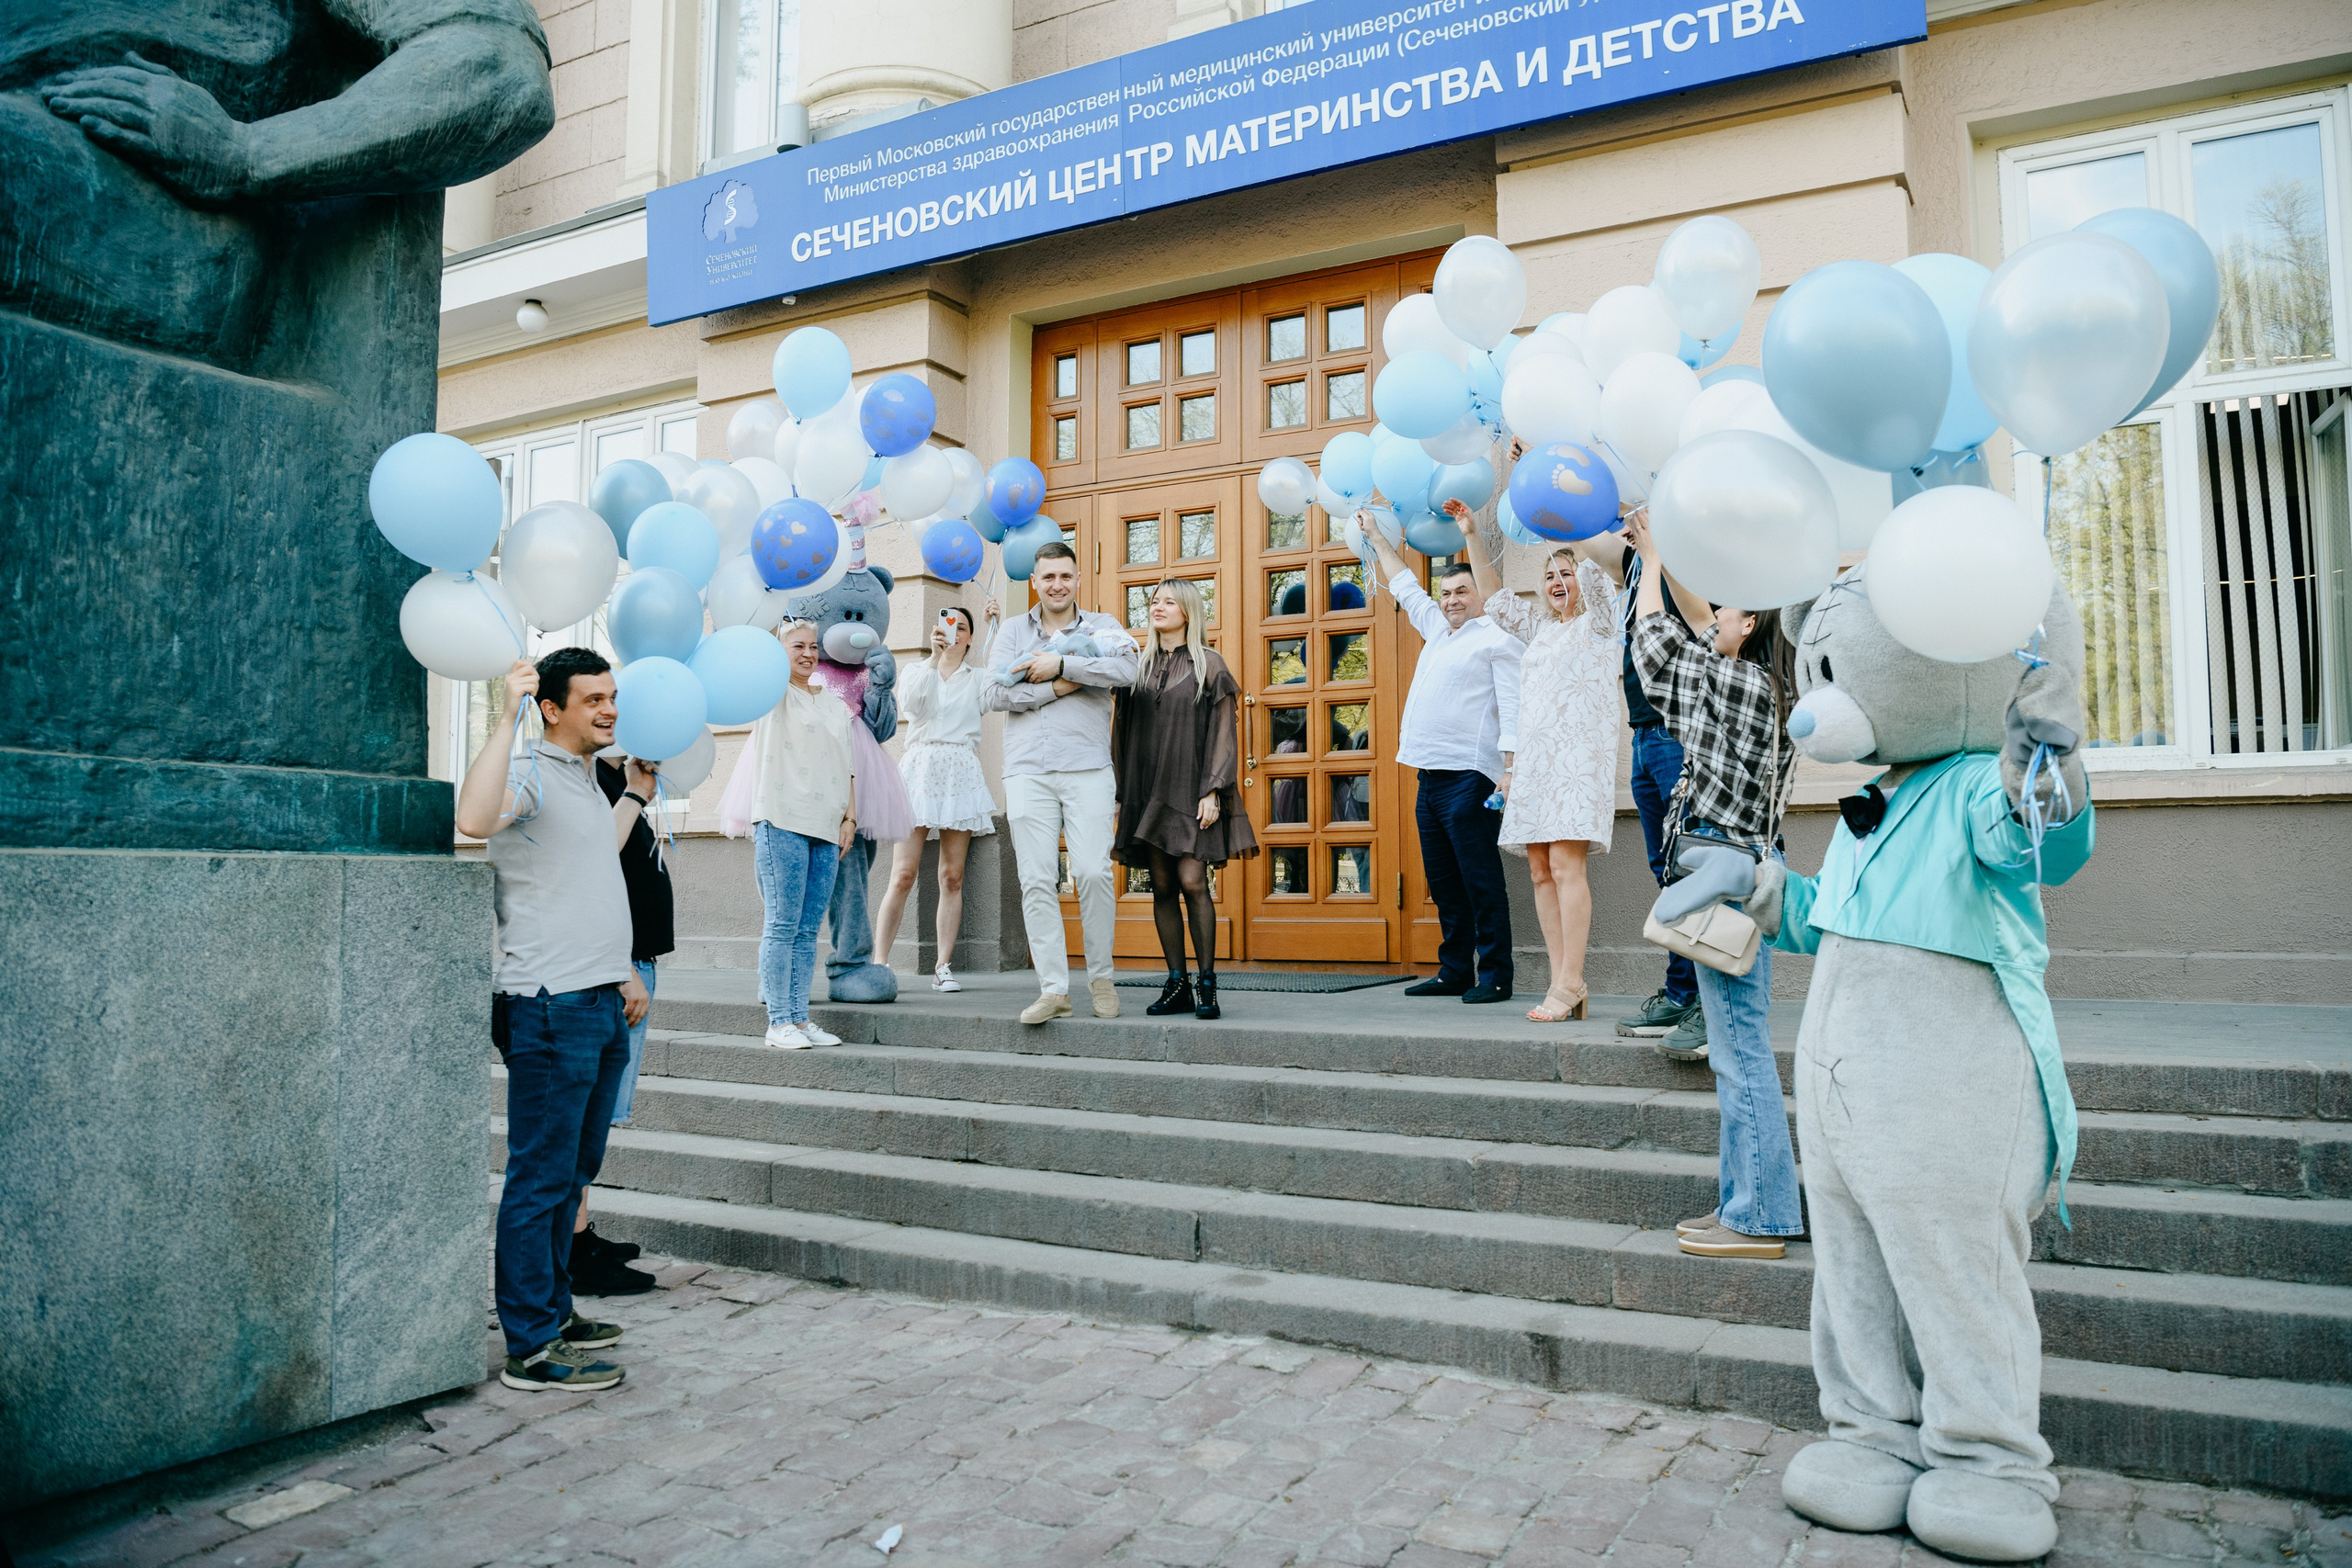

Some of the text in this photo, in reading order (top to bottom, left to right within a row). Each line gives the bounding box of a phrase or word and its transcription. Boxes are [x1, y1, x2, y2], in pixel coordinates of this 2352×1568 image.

[791, 0, 1805, 263] СЕЧЕНОВСКИЙ ЦЕНТР МАТЕРИНСТВА И ДЕТСТВА
[807, 154, 873, 186] Первый
[877, 122, 987, 168] Московский
[991, 73, 1164, 138] государственный
[1170, 31, 1314, 88] медицинский
[824, 160, 948, 204] Министерства
[953, 113, 1120, 173] здравоохранения
[1129, 73, 1256, 123] Российской
[1261, 42, 1390, 87] Федерации
